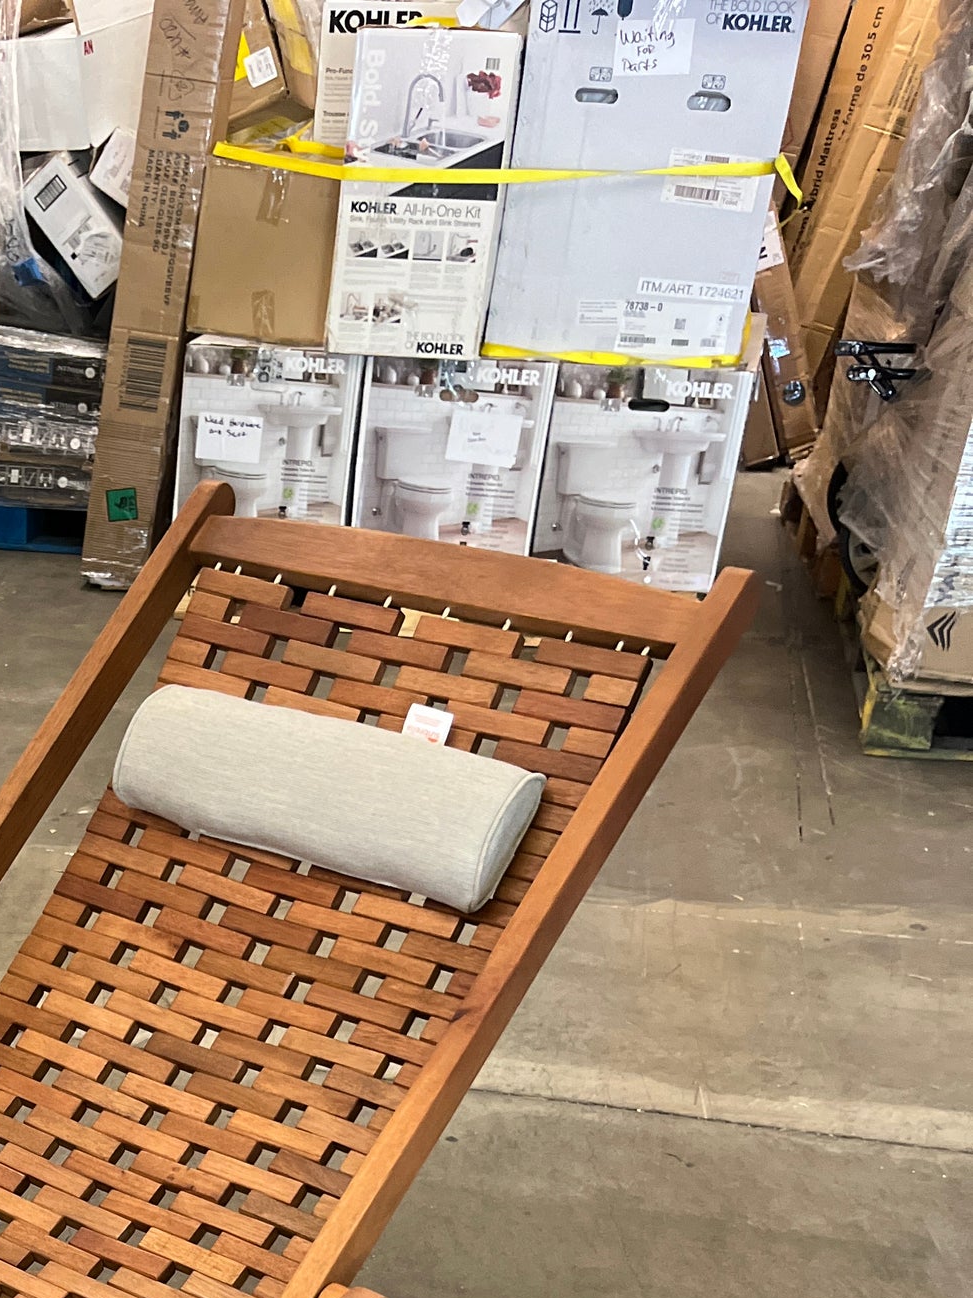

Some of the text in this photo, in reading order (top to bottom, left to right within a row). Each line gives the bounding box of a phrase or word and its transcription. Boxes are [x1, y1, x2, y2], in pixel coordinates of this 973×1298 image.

[731, 1, 761, 12] BOLD
[763, 2, 795, 13] LOOK
[722, 14, 793, 32] KOHLER
[873, 6, 885, 28] cm
[620, 26, 675, 48] Waiting
[861, 32, 877, 61] 30.5
[856, 64, 867, 82] de
[819, 109, 841, 166] Mattress
[145, 149, 155, 178] MADE
[139, 196, 149, 228] CHINA
[351, 202, 481, 219] KOHLER All-In-One Kit
[641, 280, 745, 300] ITM./ART. 1724621
[625, 301, 649, 311] 78738
[417, 342, 463, 356] KOHLER
[284, 356, 346, 374] KOHLER
[478, 368, 540, 386] KOHLER
[666, 380, 734, 400] KOHLER
